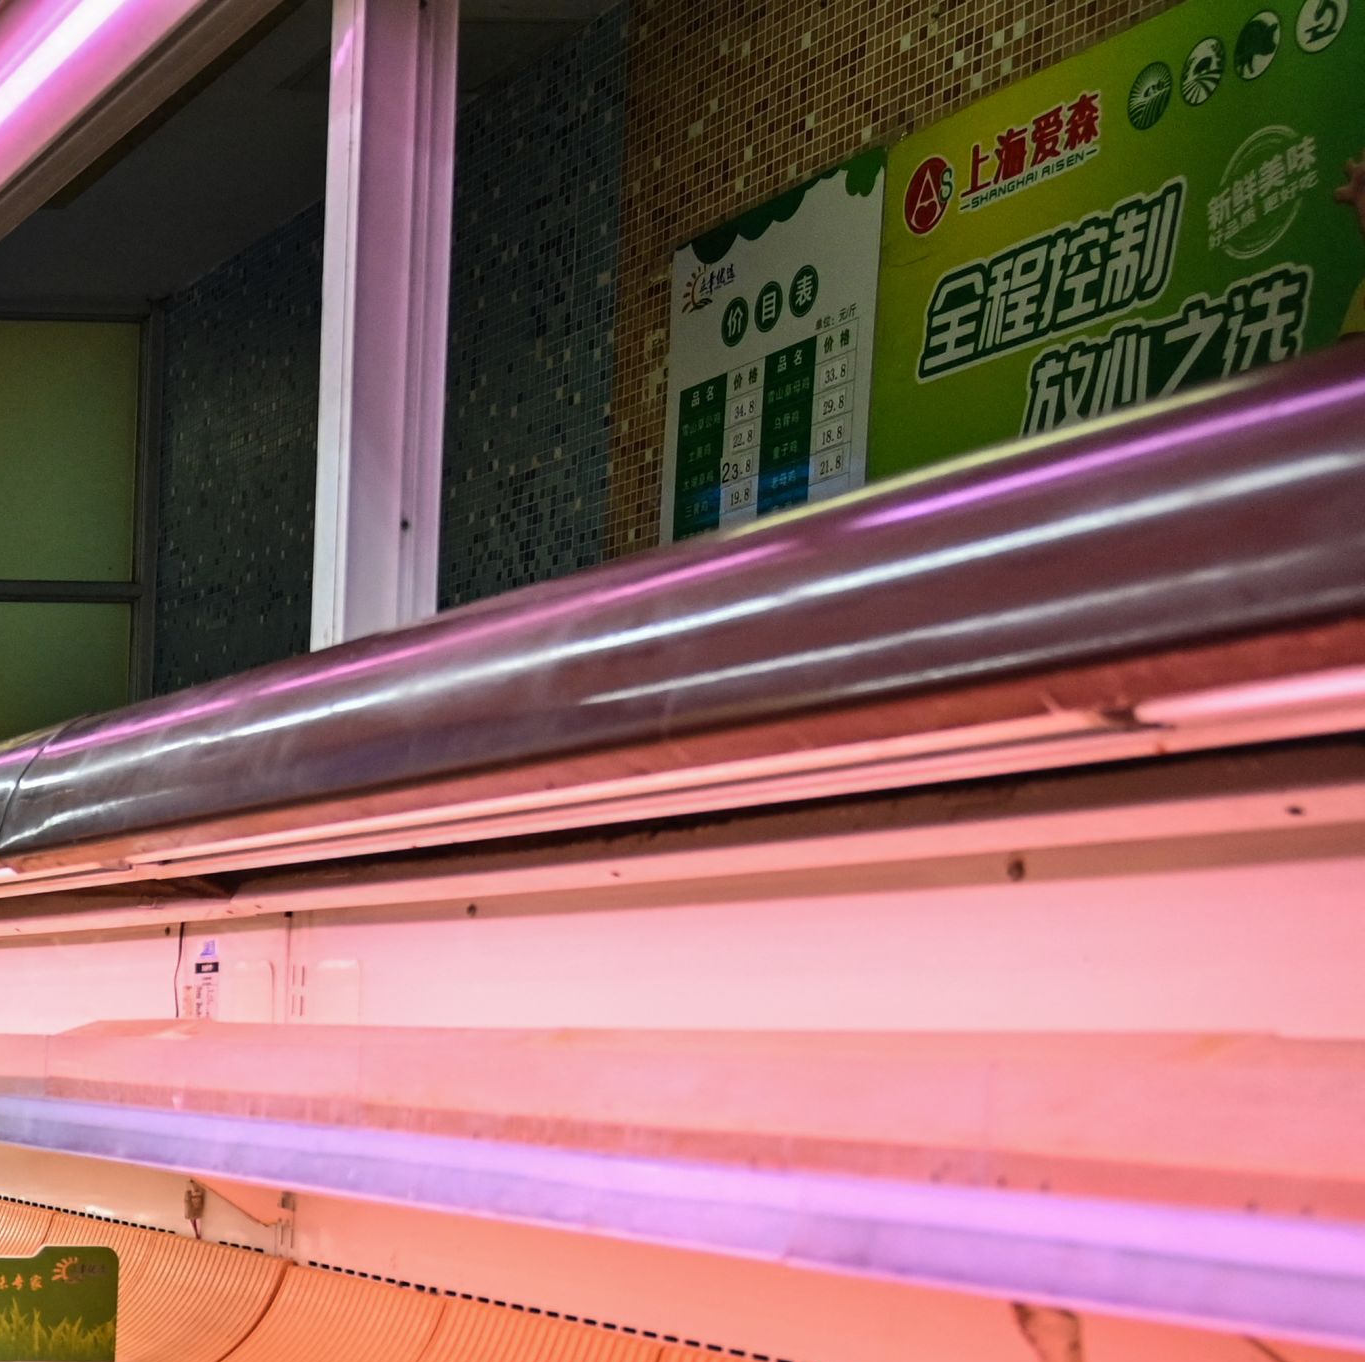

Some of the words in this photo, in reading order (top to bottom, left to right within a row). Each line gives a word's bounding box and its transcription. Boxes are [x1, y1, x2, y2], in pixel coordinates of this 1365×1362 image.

[961, 94, 1099, 198] 上海爱森
[971, 171, 1038, 209] SHANGHAI
[1041, 150, 1085, 178] RISEN
[1207, 135, 1317, 231] 新鲜美味
[921, 183, 1182, 377] 全程控制
[725, 272, 816, 339] 价目表
[823, 328, 850, 354] 价格
[1023, 268, 1312, 437] 放心之选
[777, 349, 804, 373] 品名
[733, 366, 758, 391] 价格
[824, 363, 847, 384] 33.8
[691, 385, 715, 408] 品名
[822, 394, 844, 416] 29.8
[734, 400, 755, 419] 34.8
[732, 429, 753, 449] 22.8
[821, 425, 843, 446] 18.8
[722, 458, 752, 484] 23.8
[819, 455, 842, 475] 21.8
[730, 487, 750, 506] 19.8
